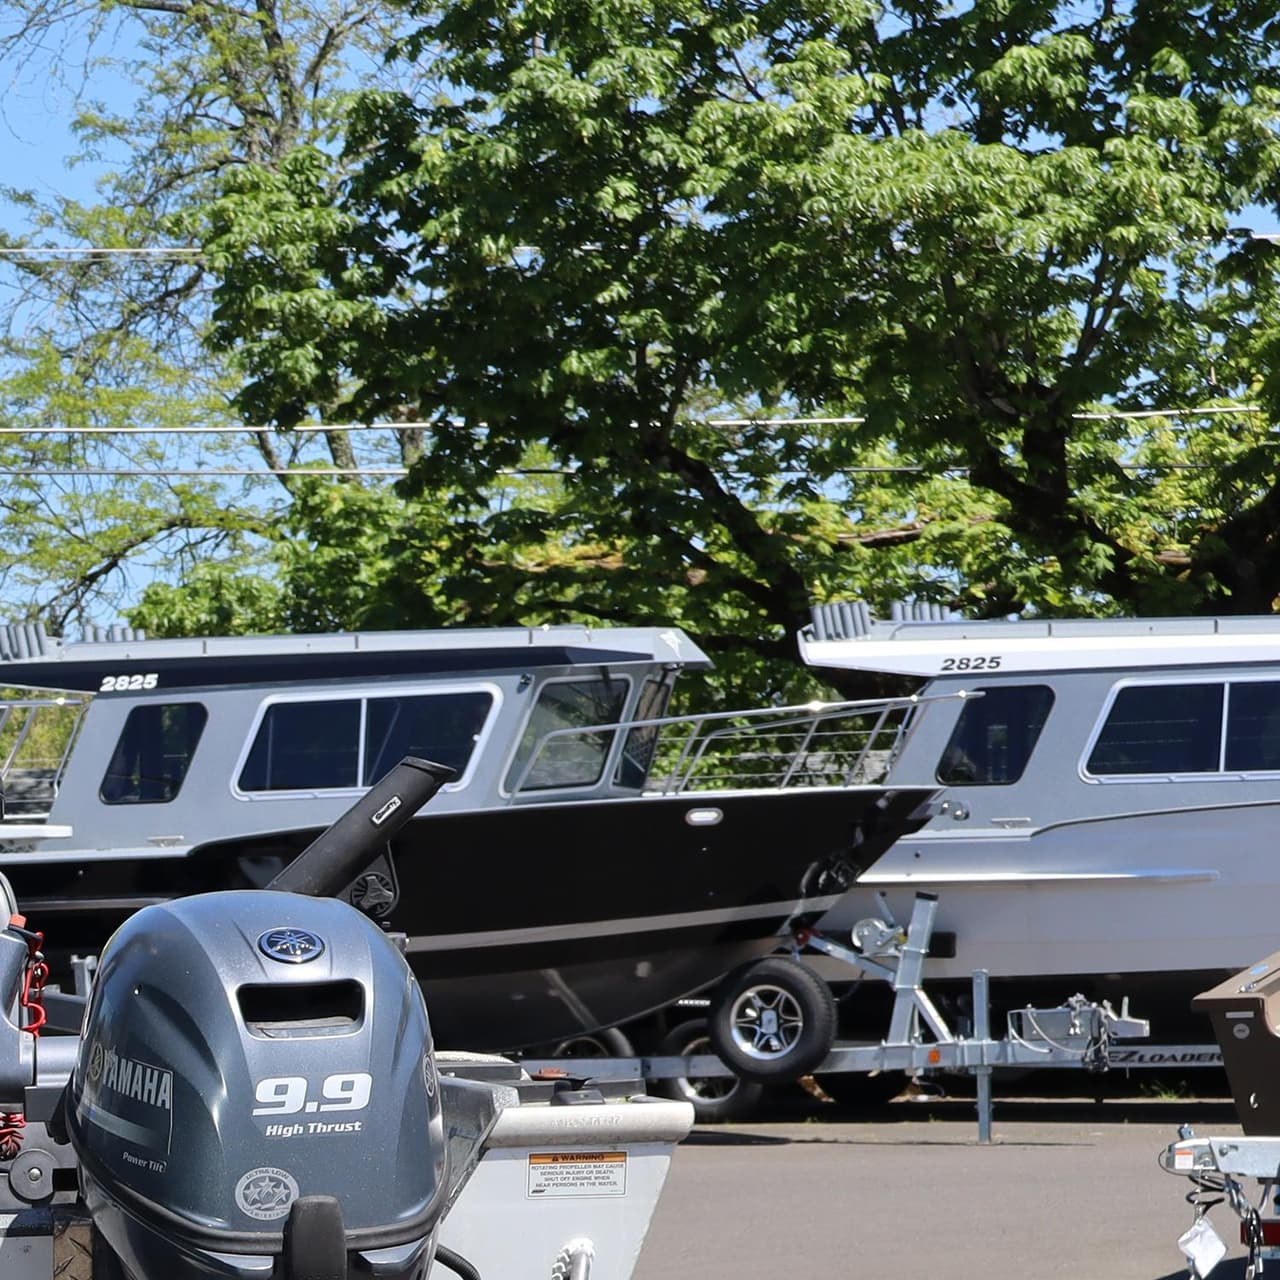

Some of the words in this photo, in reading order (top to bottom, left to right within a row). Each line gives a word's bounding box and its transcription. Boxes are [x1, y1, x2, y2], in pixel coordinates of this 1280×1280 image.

[941, 656, 1002, 671] 2825
[99, 673, 159, 692] 2825
[103, 1048, 171, 1110] YAMAHA
[252, 1072, 373, 1116] 9.9
[265, 1124, 304, 1137] High
[307, 1120, 362, 1134] Thrust
[122, 1151, 148, 1167] Power
[148, 1160, 164, 1173] Tilt
[561, 1154, 605, 1162] WARNING
